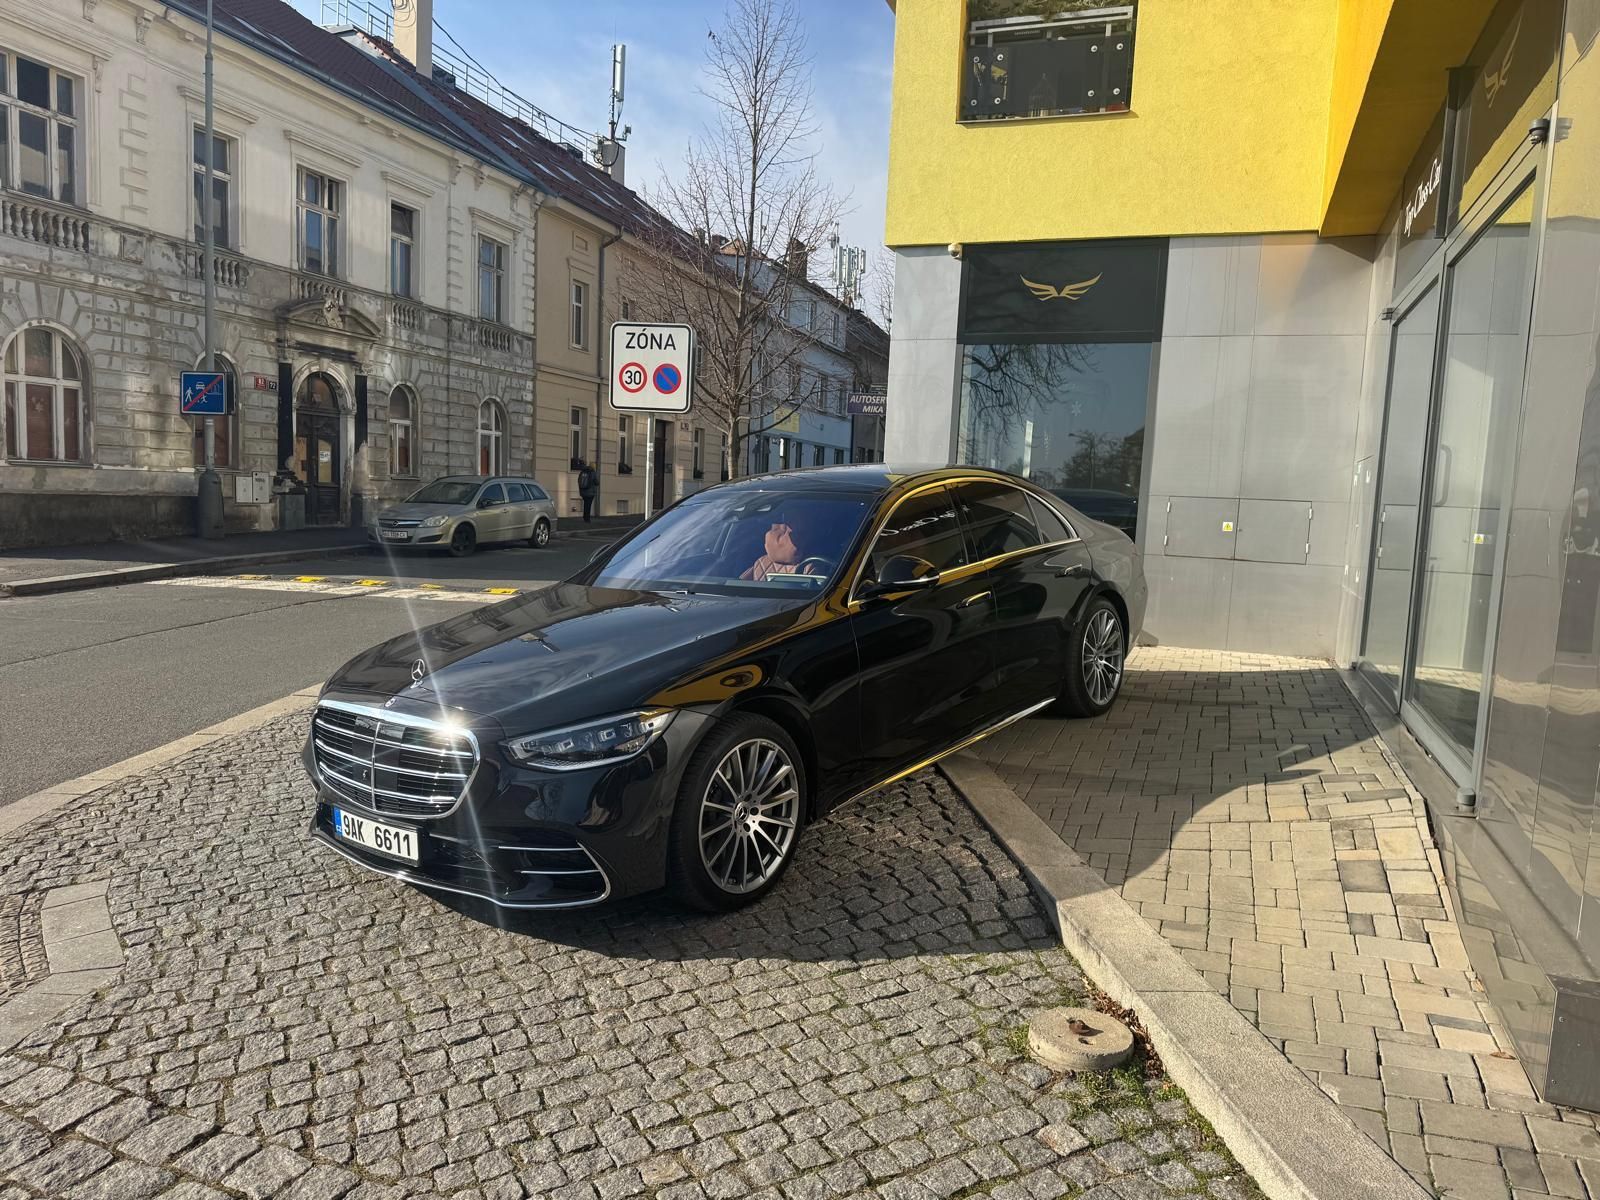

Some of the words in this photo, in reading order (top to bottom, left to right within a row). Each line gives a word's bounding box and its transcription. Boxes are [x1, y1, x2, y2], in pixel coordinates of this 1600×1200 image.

[625, 328, 677, 351] ZÓNA
[624, 370, 642, 385] 30
[862, 405, 884, 413] MIKA
[342, 814, 366, 844] 9AK
[374, 825, 411, 857] 6611
